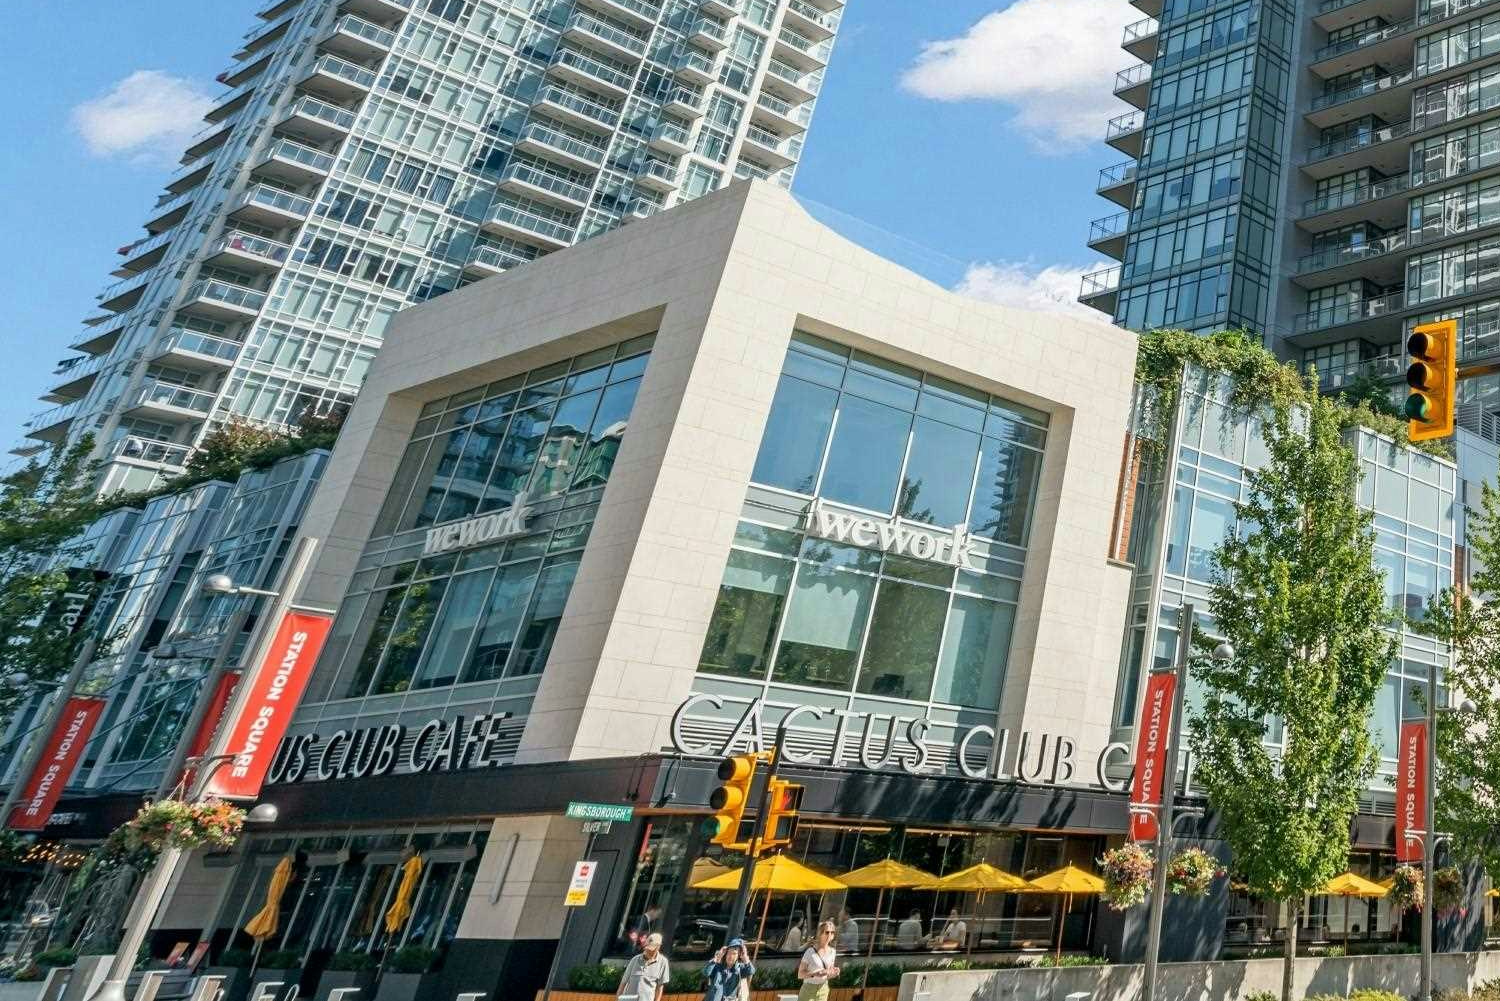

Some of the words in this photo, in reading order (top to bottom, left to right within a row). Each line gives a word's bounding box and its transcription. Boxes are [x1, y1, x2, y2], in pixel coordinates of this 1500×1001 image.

[423, 490, 535, 556] wework
[815, 506, 976, 568] wework
[266, 631, 308, 701] STATION
[54, 710, 88, 760] STATION
[232, 705, 275, 778] SQUARE
[317, 723, 404, 781] CLUB
[409, 711, 511, 774] CAFE
[670, 693, 932, 775] CACTUS
[957, 725, 1077, 785] CLUB
[1147, 689, 1164, 752] STATION
[26, 763, 61, 816] SQUARE
[1407, 736, 1417, 789] STATION
[567, 804, 627, 819] KINGSBOROUGH
